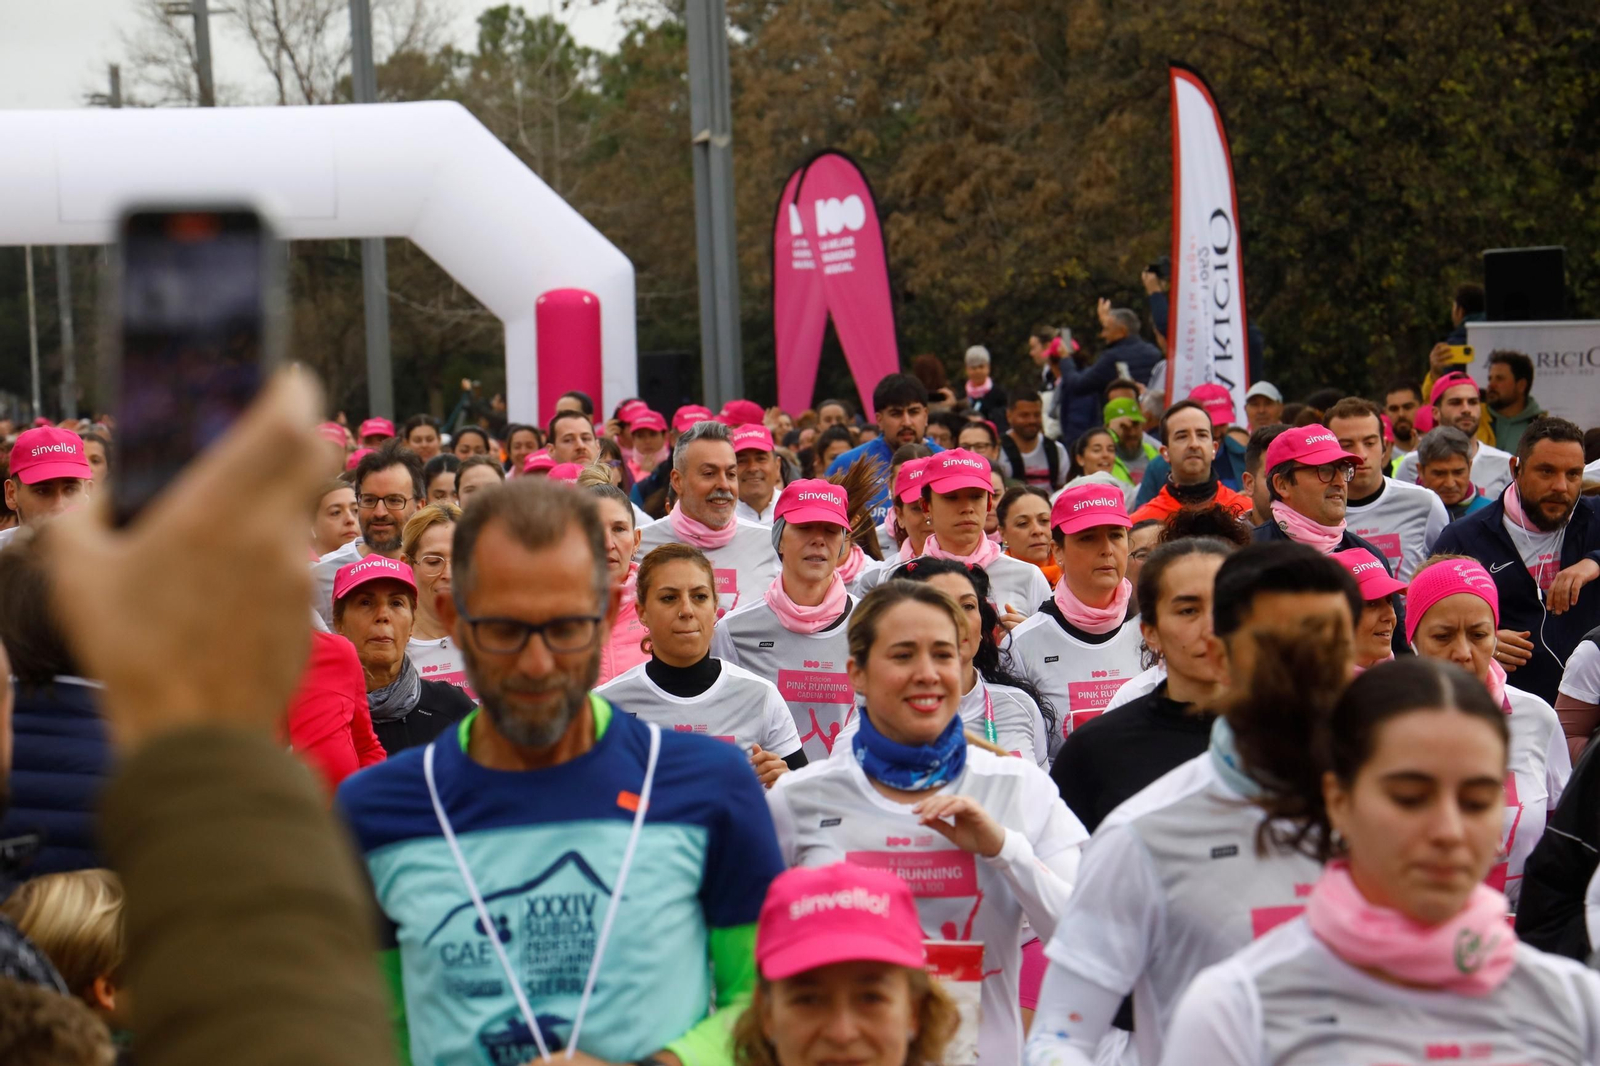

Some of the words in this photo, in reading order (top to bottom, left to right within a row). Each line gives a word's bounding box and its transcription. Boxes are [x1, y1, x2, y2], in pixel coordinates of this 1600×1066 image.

[815, 194, 866, 236] 100
[733, 430, 765, 441] sinvello!
[31, 442, 77, 457] sinvello!
[942, 458, 984, 470] sinvello!
[798, 490, 842, 507] sinvello!
[1073, 497, 1118, 512] sinvello!
[350, 558, 400, 576] sinvello!
[422, 665, 438, 673] 100
[803, 660, 820, 668] 100
[1091, 670, 1107, 678] 100
[786, 681, 806, 690] PINK
[809, 682, 848, 692] RUNNING
[797, 691, 824, 699] CADENA
[825, 692, 836, 700] 100
[1078, 691, 1099, 699] PINK
[897, 866, 963, 880] RUNNING
[526, 893, 597, 918] XXXIV
[789, 886, 891, 921] sinvello!
[440, 941, 492, 968] CAE
